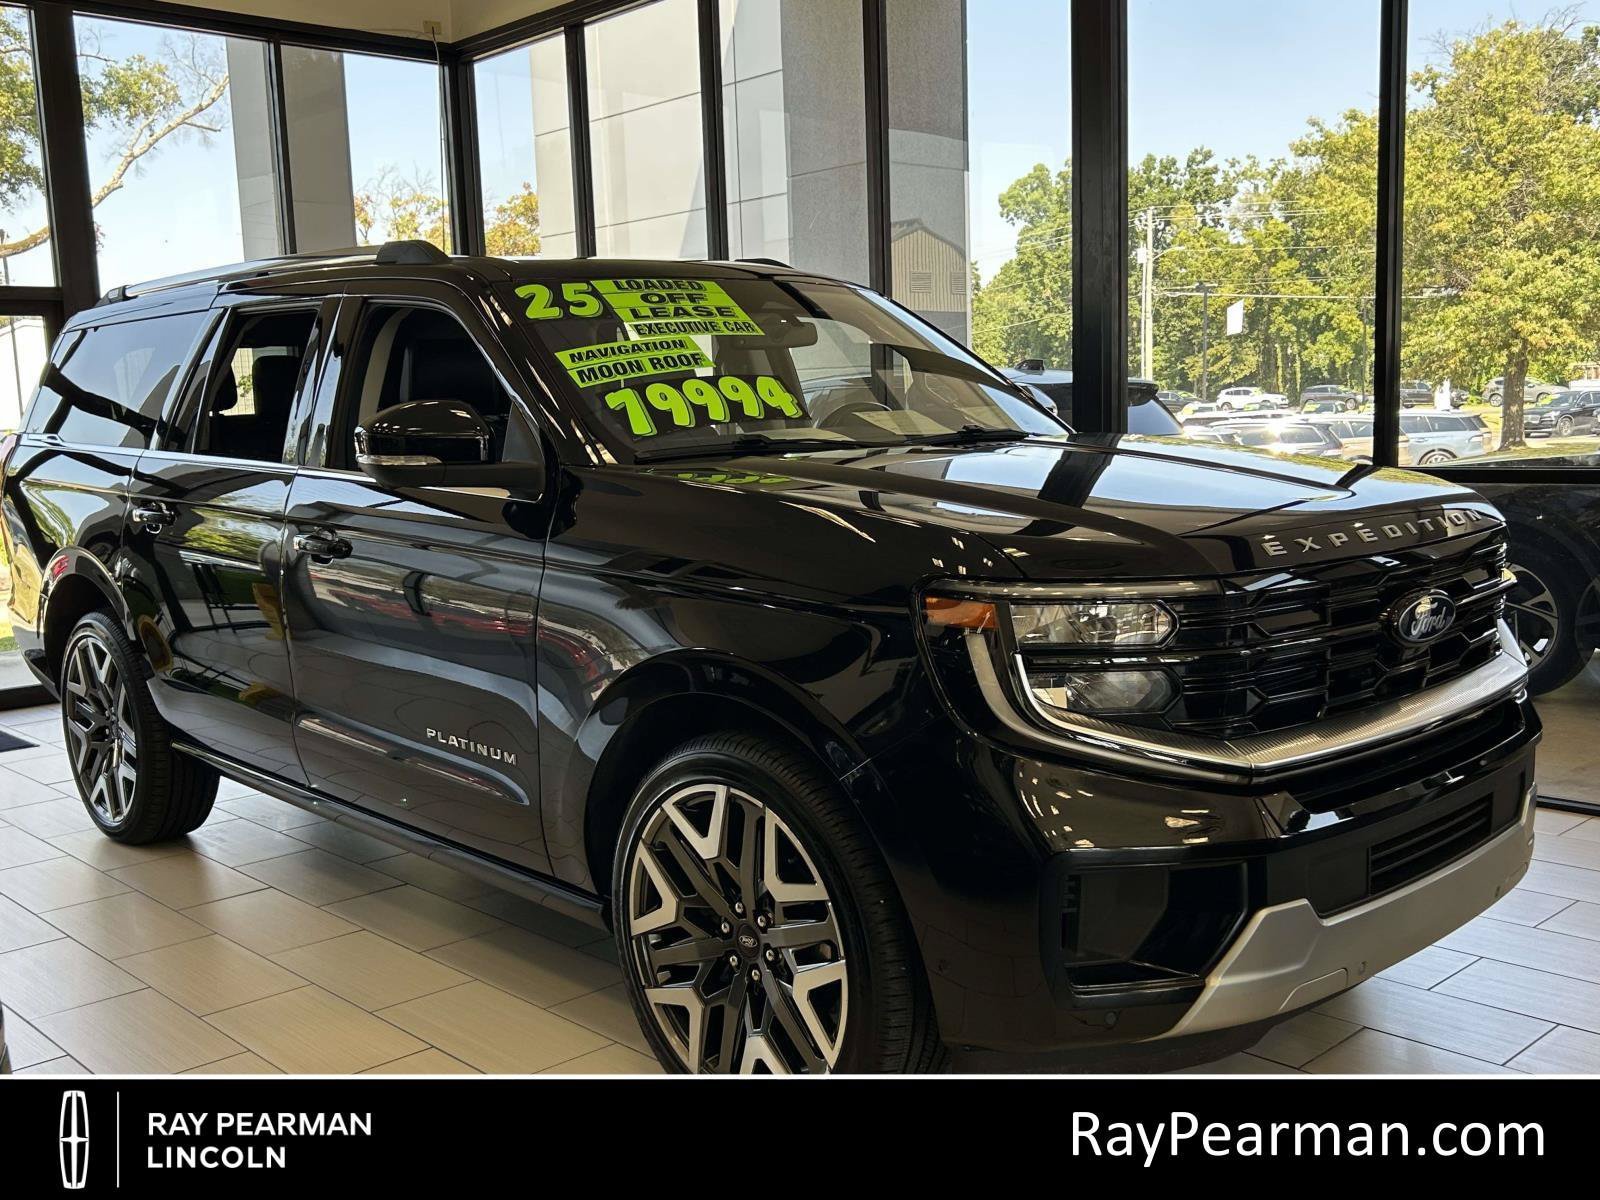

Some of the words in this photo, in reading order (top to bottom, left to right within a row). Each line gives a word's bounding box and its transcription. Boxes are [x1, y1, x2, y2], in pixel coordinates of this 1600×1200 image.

[612, 279, 707, 292] LOADED
[640, 292, 708, 305] OFF
[514, 282, 603, 320] 25
[628, 305, 736, 319] LEASE
[634, 321, 721, 336] EXECUTIVE
[723, 320, 756, 334] CAR
[568, 338, 687, 364] NAVIGATION
[576, 357, 645, 384] MOON
[651, 351, 704, 372] ROOF
[604, 375, 803, 437] 79994
[1260, 509, 1483, 557] EXPEDITION
[425, 727, 518, 766] PLATINUM
